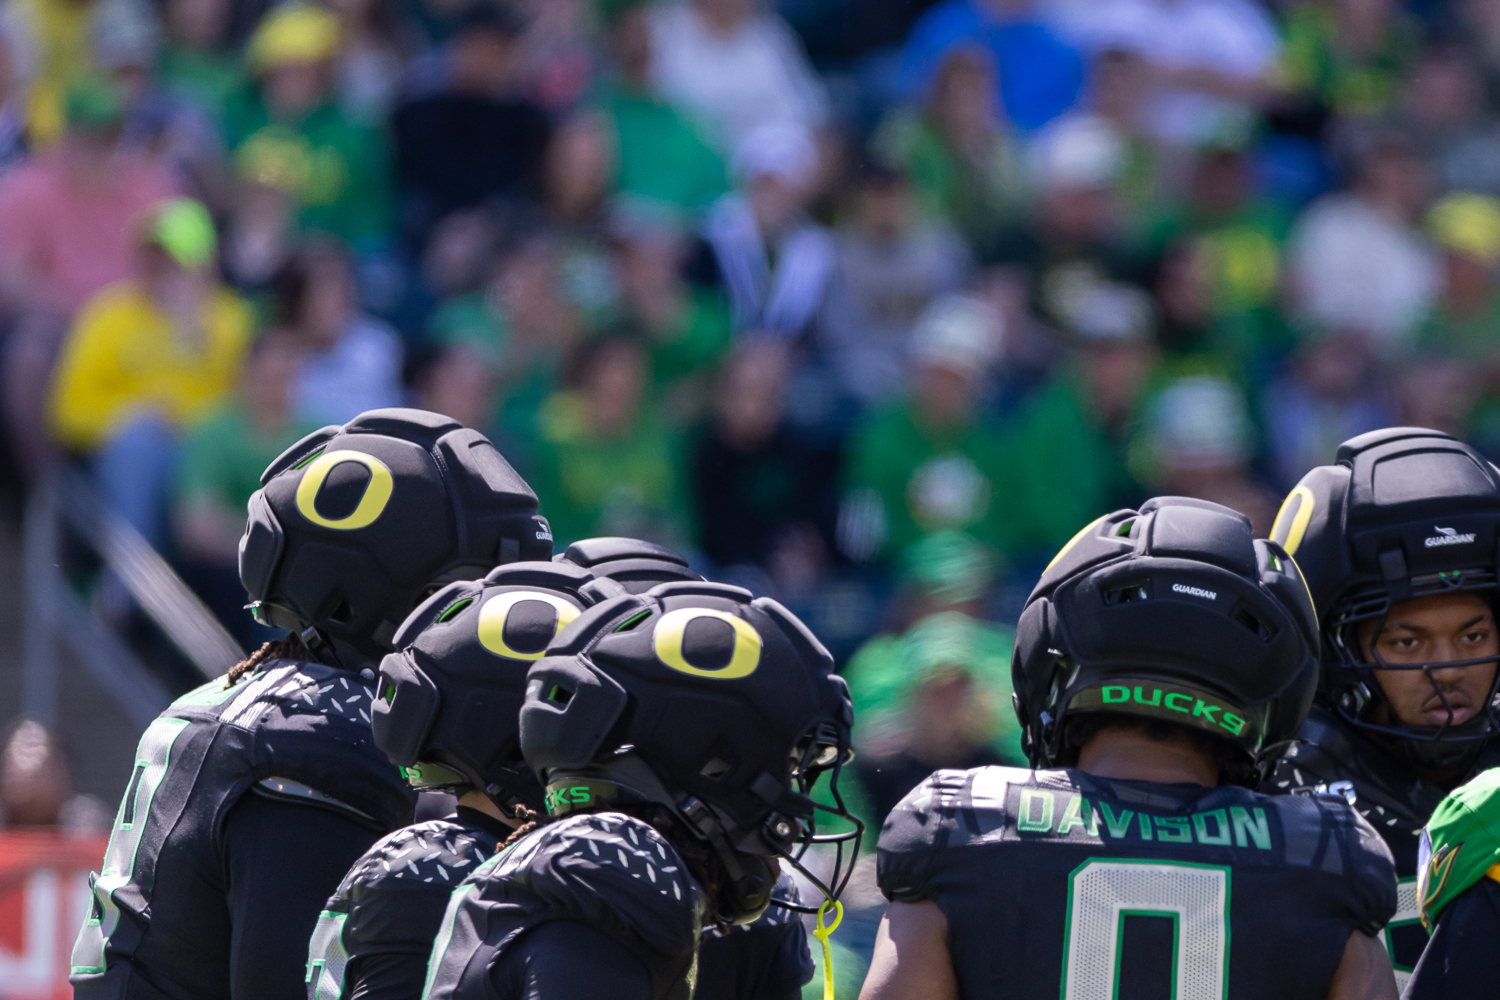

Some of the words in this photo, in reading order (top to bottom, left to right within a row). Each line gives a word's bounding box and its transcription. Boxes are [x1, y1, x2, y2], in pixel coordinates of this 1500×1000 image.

[296, 449, 394, 530] O
[1424, 533, 1476, 548] GUARDIAN
[1172, 583, 1217, 600] GUARDIAN
[653, 607, 762, 679] O
[1102, 685, 1247, 735] DUCKS
[1017, 789, 1272, 850] DAVISON
